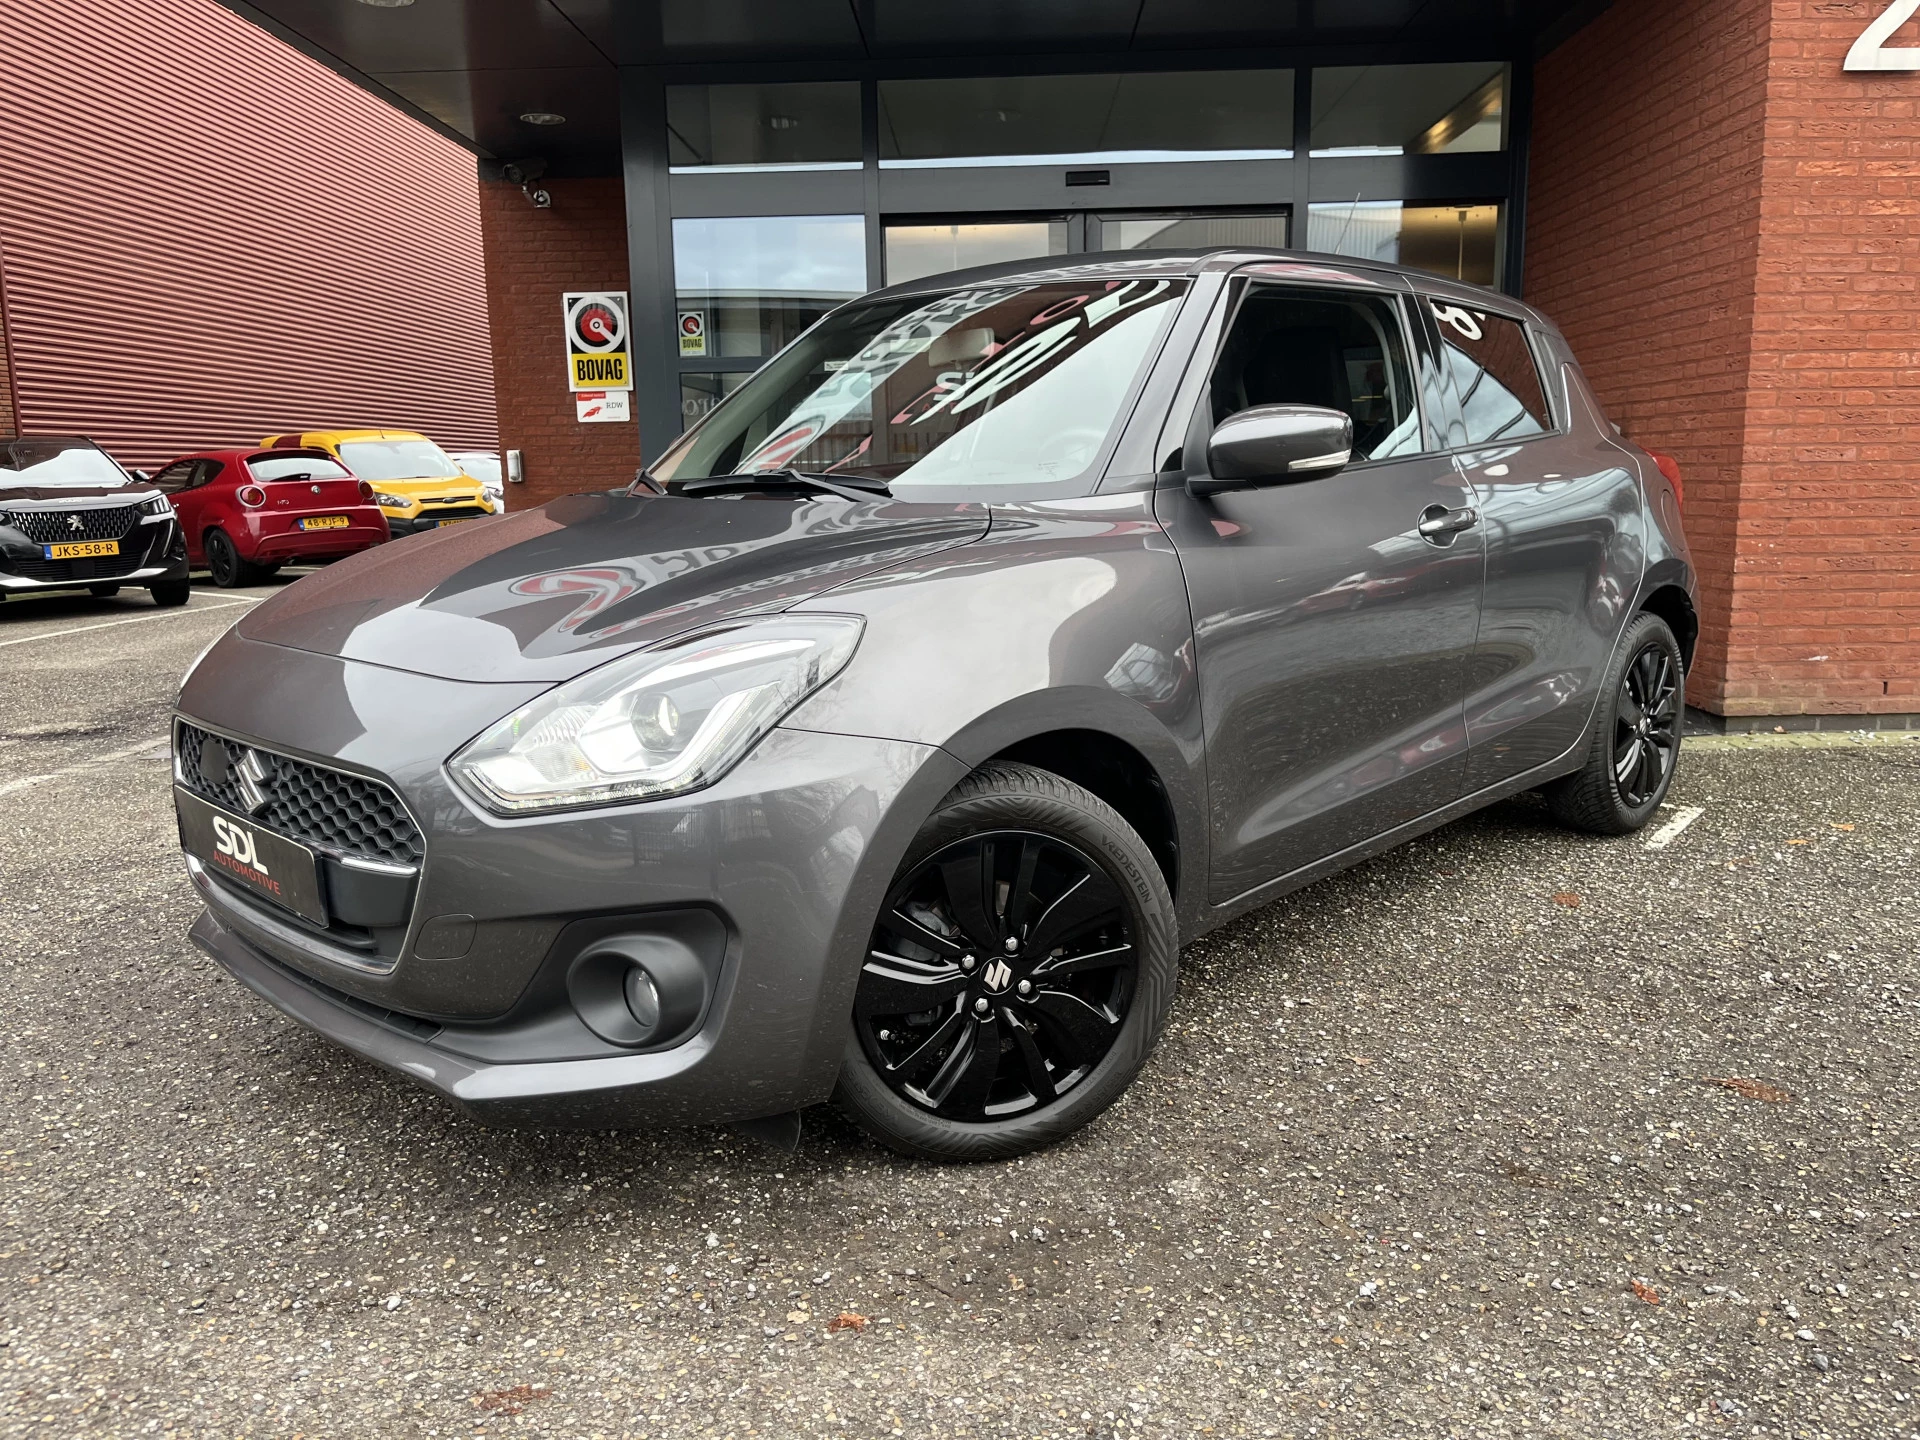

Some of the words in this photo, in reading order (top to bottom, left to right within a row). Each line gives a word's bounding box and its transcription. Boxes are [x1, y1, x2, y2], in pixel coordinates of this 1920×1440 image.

[683, 338, 702, 349] BOVAG
[576, 358, 623, 381] BOVAG
[56, 543, 114, 557] JKS-58-R
[212, 815, 269, 876] SDL
[213, 850, 281, 896] AUTOMOTIVE
[1101, 833, 1153, 904] VREDESTEIN
